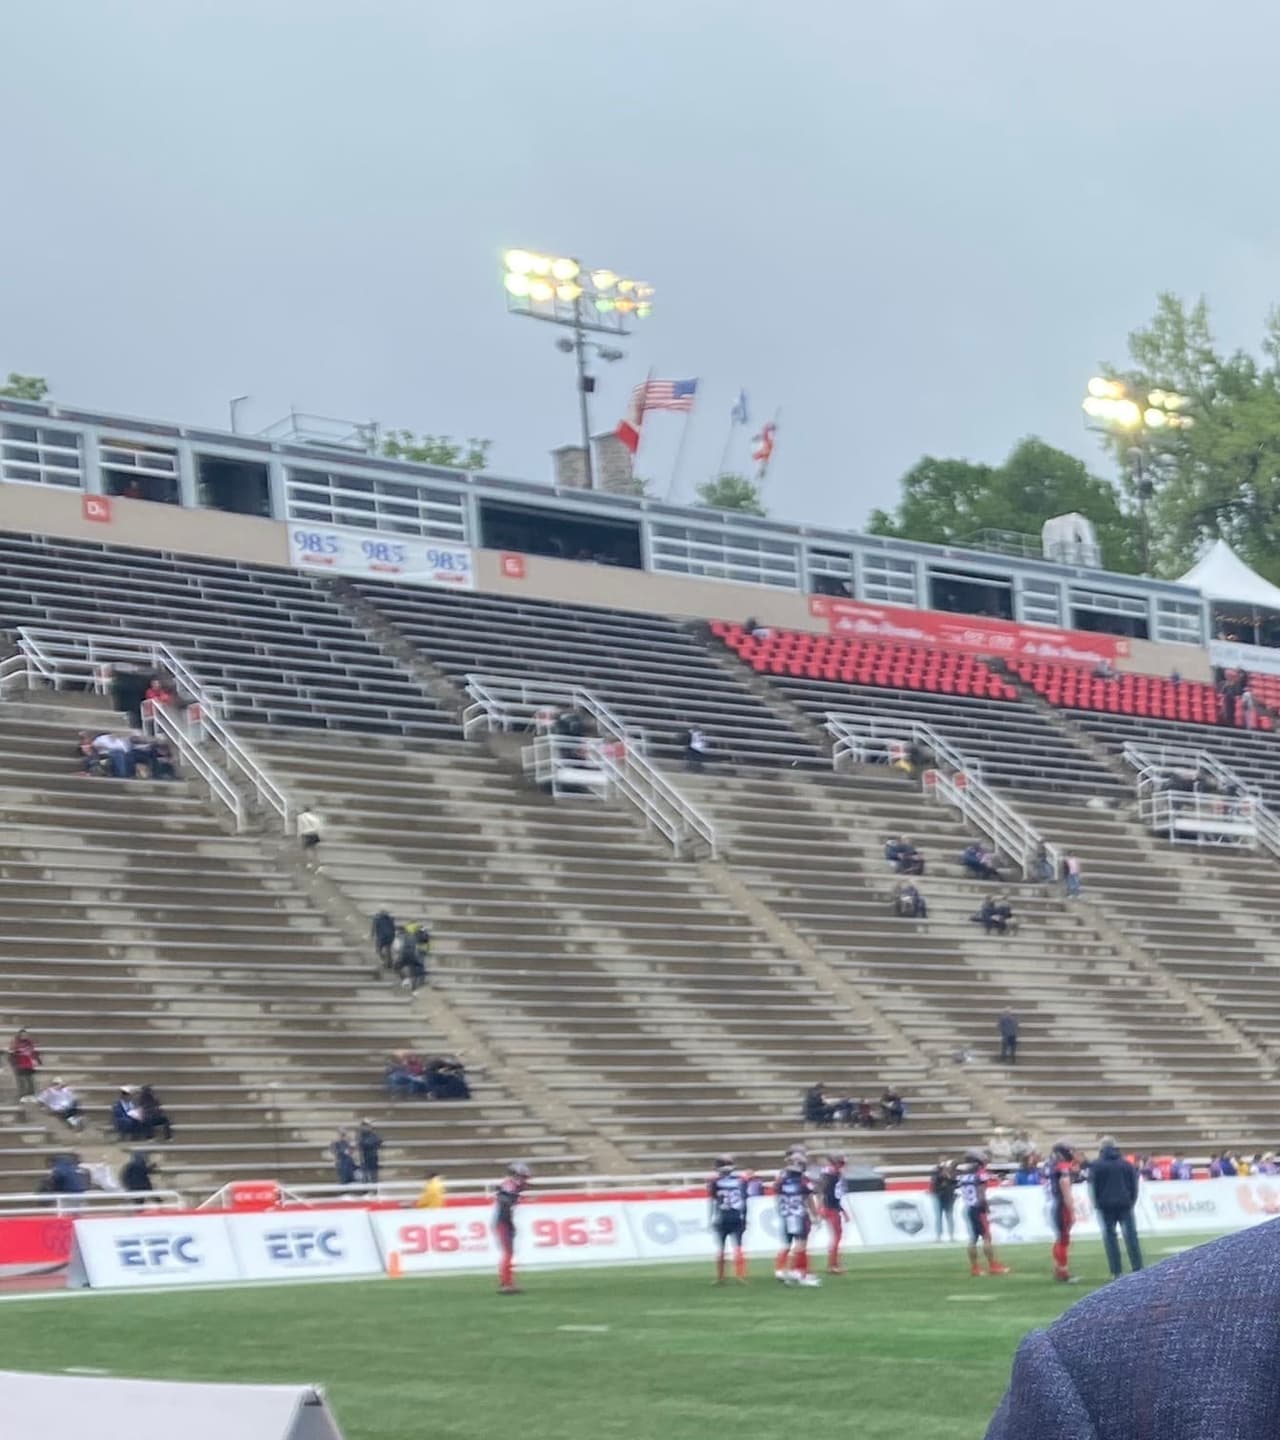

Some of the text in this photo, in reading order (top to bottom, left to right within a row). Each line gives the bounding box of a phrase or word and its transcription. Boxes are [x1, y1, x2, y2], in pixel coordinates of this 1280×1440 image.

[264, 1228, 343, 1260] EFC
[399, 1220, 488, 1255] 96.9
[532, 1215, 616, 1248] 96.9
[115, 1236, 200, 1266] EFC
